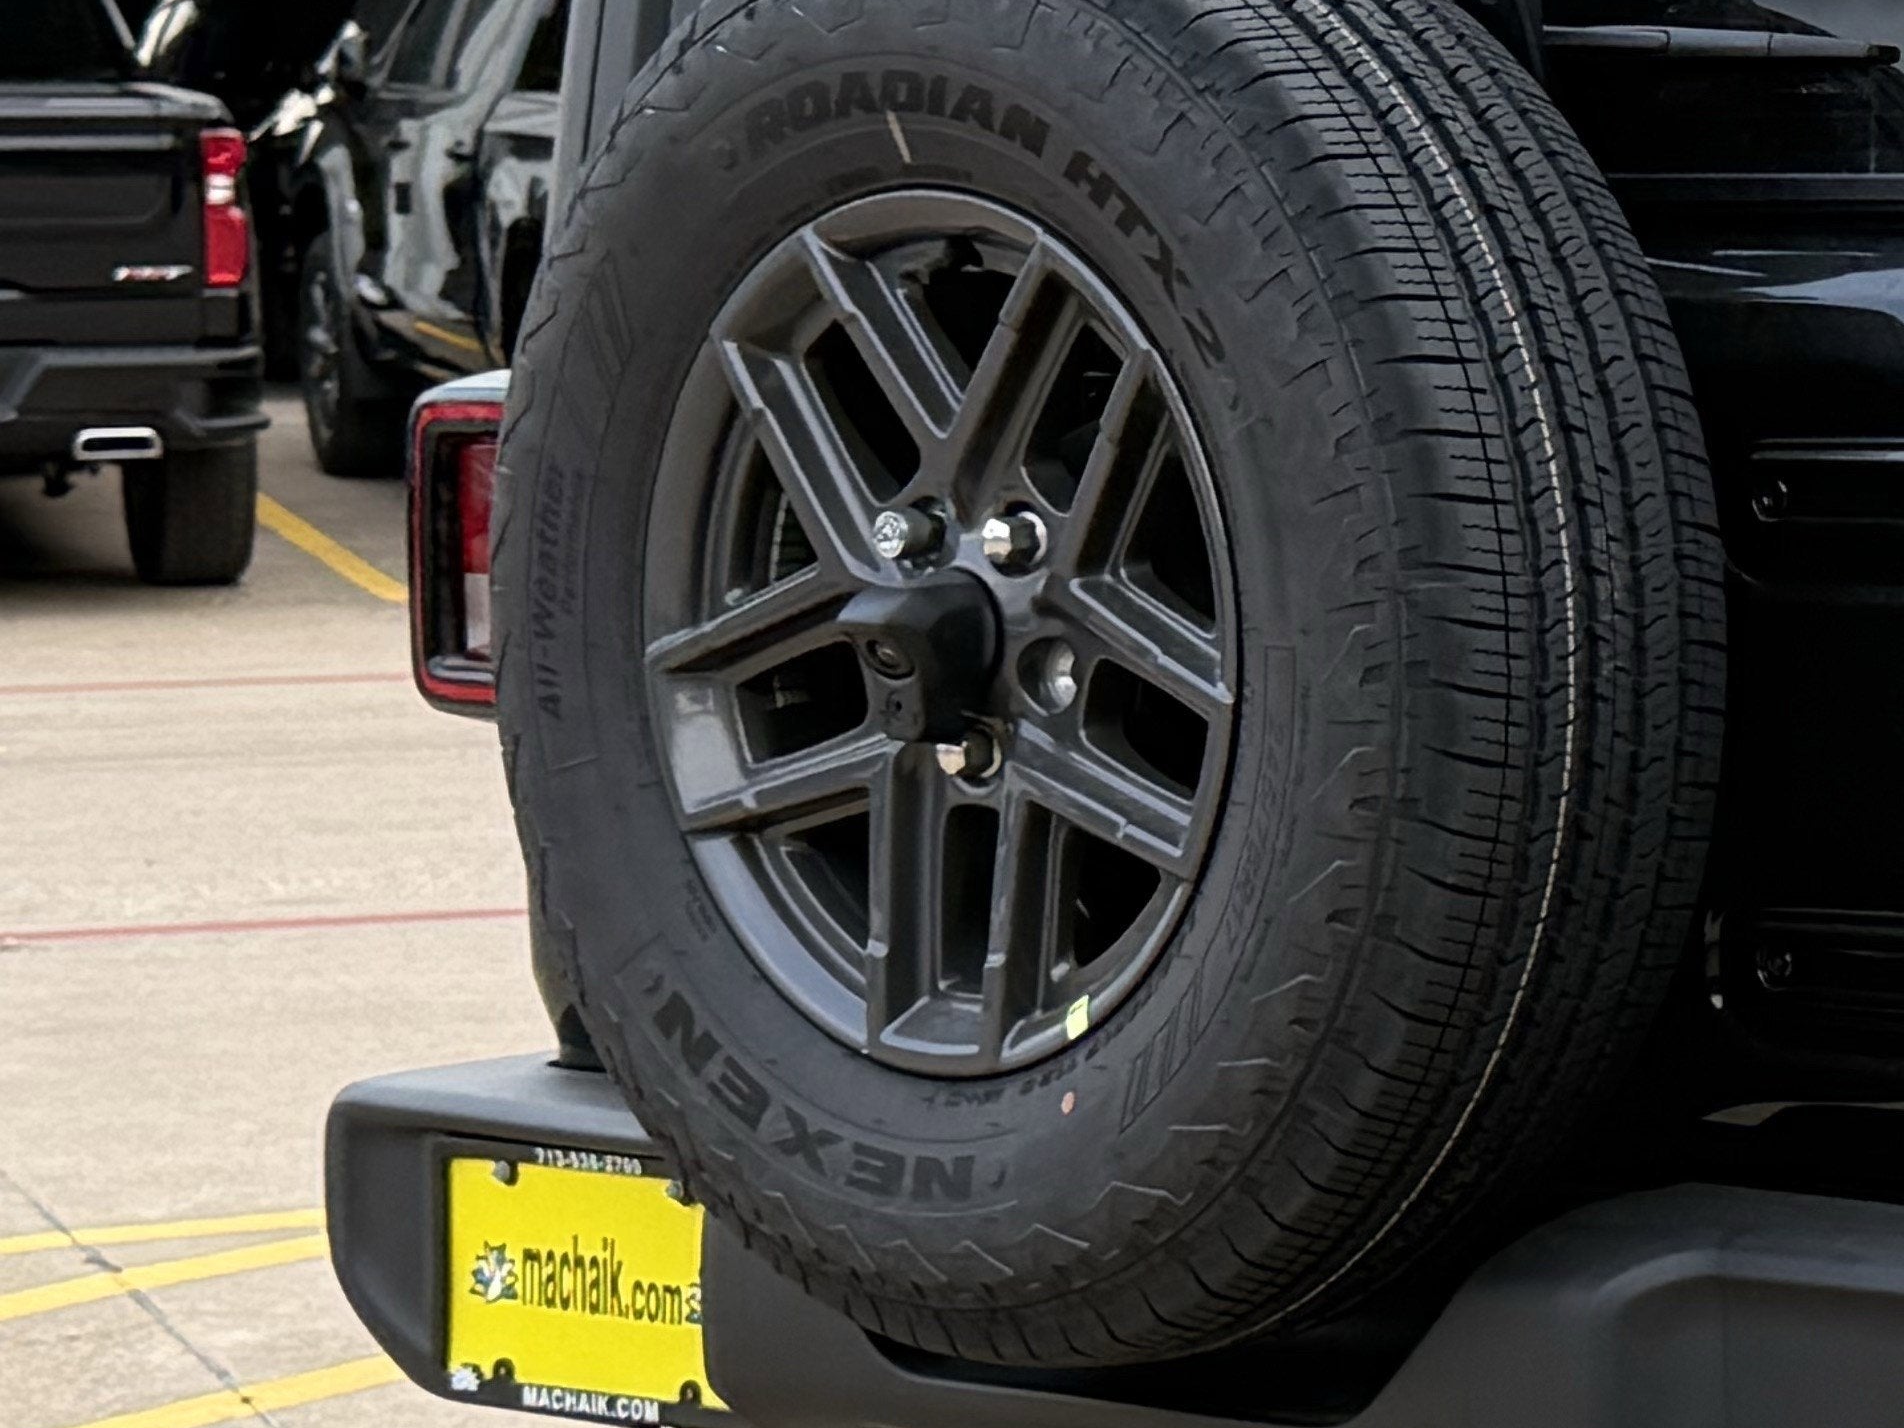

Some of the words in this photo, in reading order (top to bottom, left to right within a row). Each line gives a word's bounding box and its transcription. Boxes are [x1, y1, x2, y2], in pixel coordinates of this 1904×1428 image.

[743, 70, 1053, 158] ROADIAN
[652, 995, 976, 1203] NEXEN
[522, 1233, 683, 1326] machaik.com
[522, 1385, 660, 1422] MACHAIK.COM
